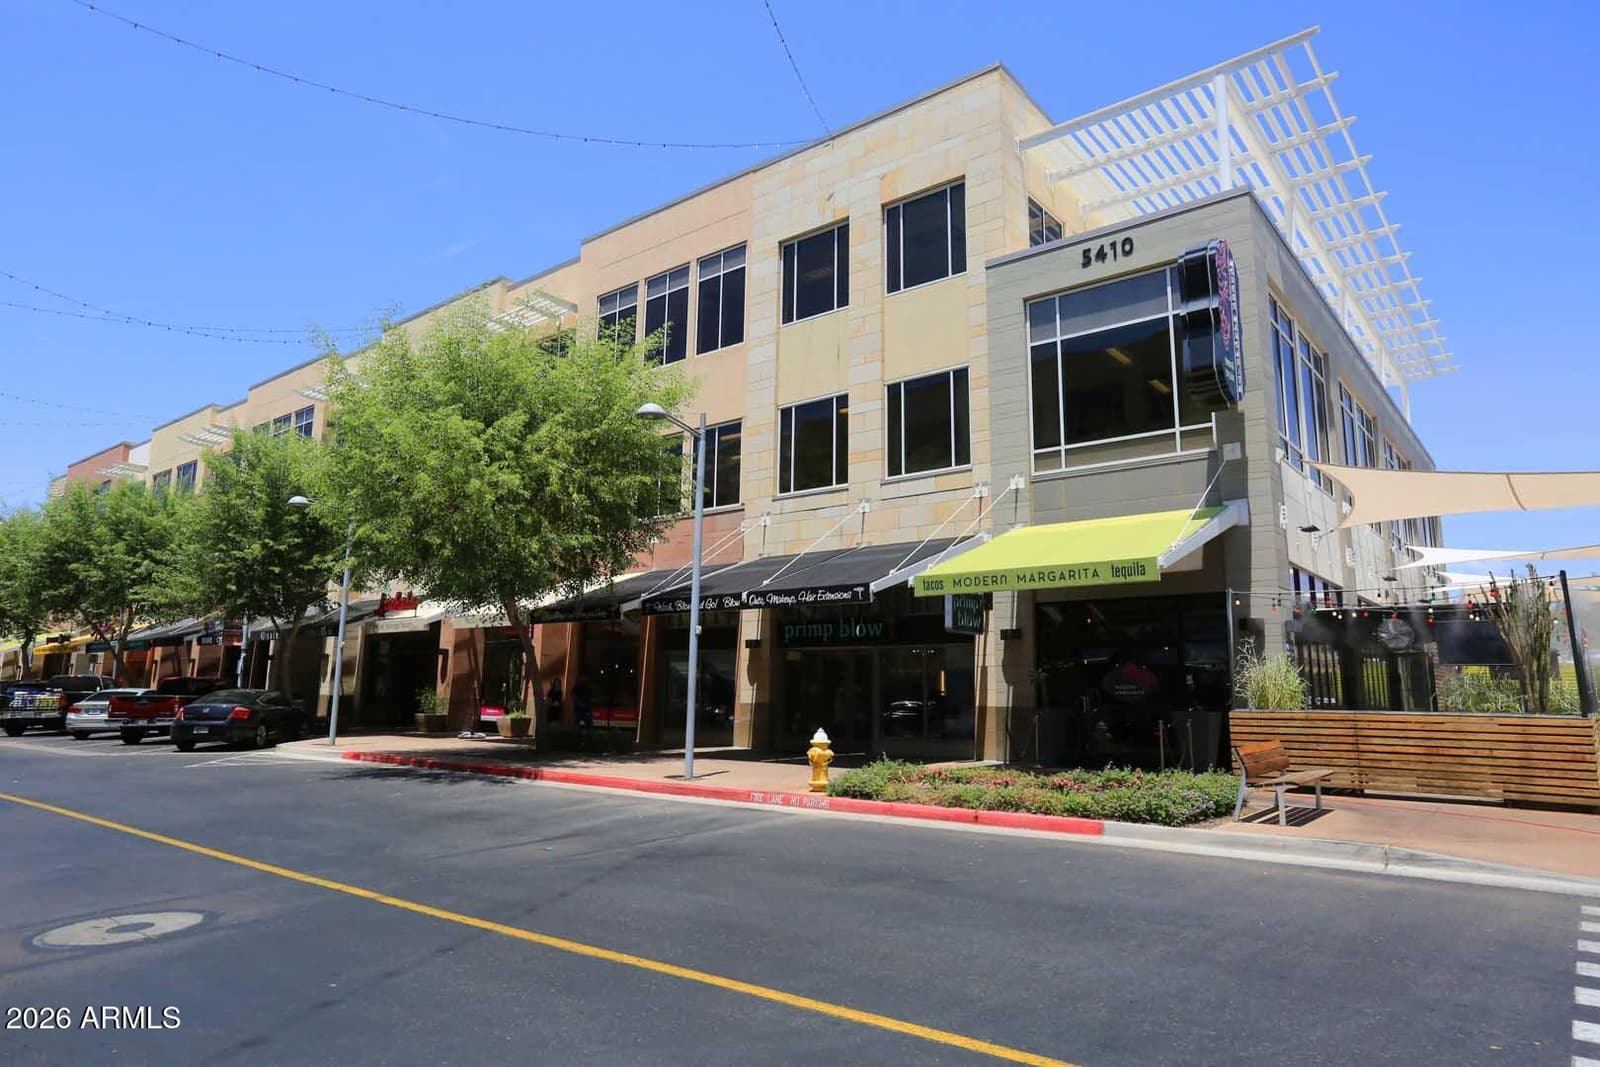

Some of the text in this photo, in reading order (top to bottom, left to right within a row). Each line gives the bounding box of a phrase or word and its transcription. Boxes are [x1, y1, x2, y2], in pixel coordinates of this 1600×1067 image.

[1081, 236, 1135, 269] 5410
[922, 561, 1147, 592] tacos MODERN MARGARITA tequila
[783, 615, 884, 643] primp blow
